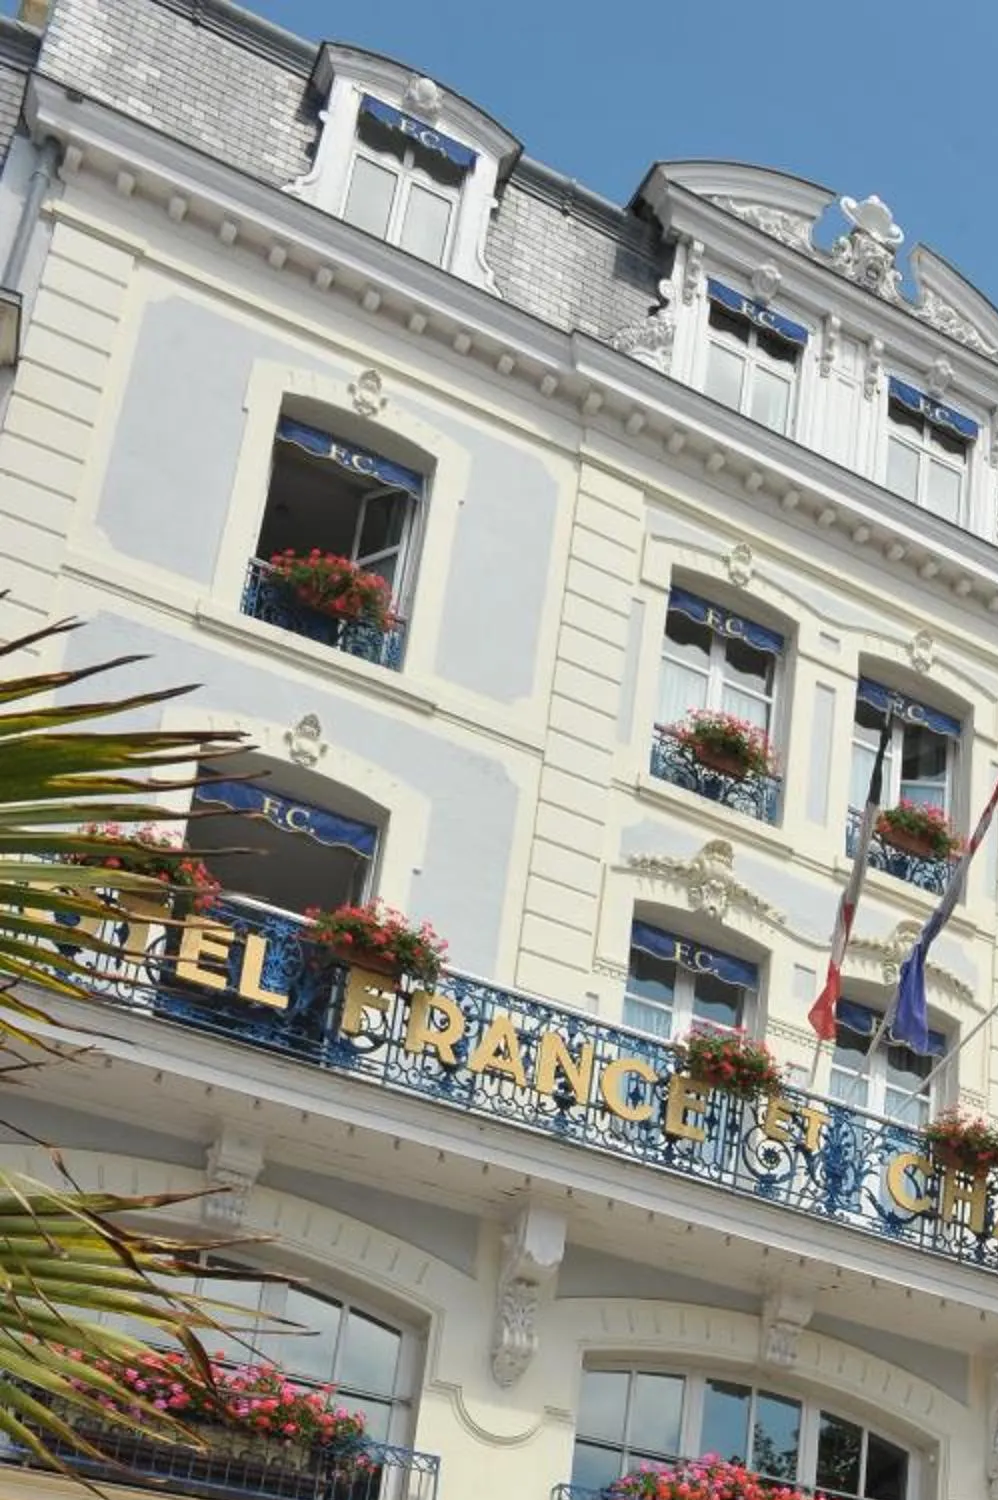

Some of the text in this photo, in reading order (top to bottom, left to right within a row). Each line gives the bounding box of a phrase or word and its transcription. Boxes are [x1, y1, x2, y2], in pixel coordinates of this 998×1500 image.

[264, 797, 315, 833] F.C.
[674, 941, 719, 974] F.C.
[340, 965, 709, 1141] FRANCE
[765, 1096, 832, 1152] ET
